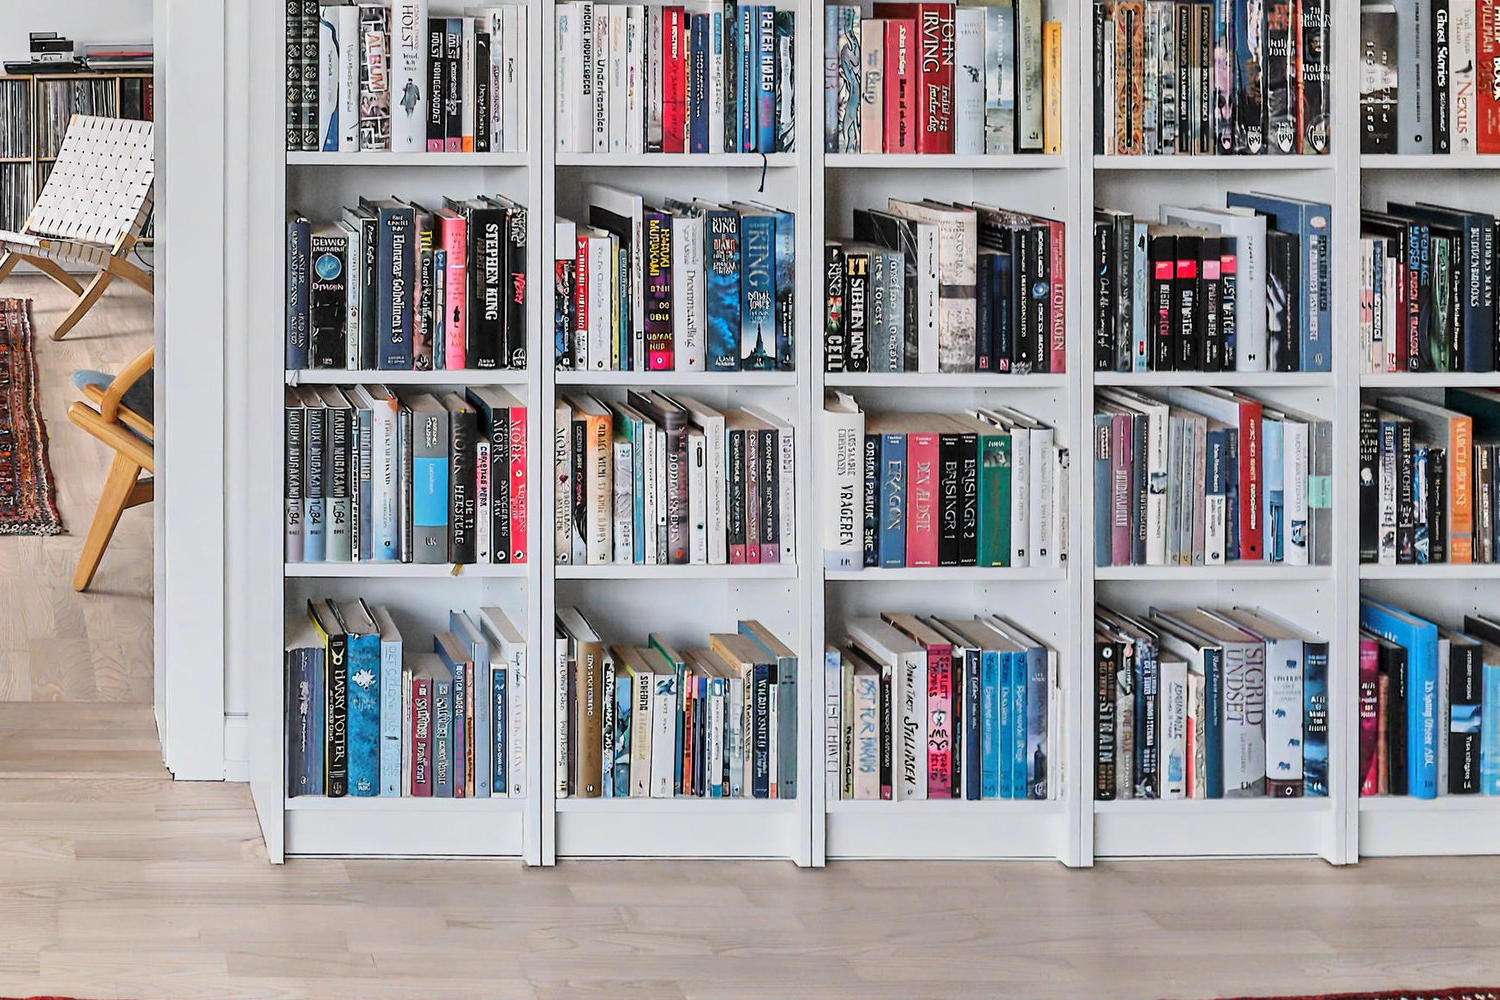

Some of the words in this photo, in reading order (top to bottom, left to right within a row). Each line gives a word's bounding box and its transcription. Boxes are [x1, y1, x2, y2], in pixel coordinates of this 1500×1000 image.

[402, 5, 413, 49] HOLST
[762, 12, 772, 51] PETER
[923, 11, 939, 72] IRVING
[942, 18, 954, 65] JOHN
[1437, 9, 1447, 43] Ghost
[366, 34, 384, 90] ALBUM
[1437, 47, 1447, 86] Stories
[1456, 81, 1471, 133] Nexus
[486, 223, 498, 285] STEPHEN
[748, 227, 766, 286] KING
[875, 256, 884, 279] new
[486, 289, 498, 320] KING
[850, 278, 864, 327] STEPHEN
[875, 287, 884, 324] forest
[828, 336, 841, 370] CELL
[851, 331, 865, 358] KING
[865, 442, 874, 479] ORHAN
[865, 482, 874, 519] PAMUK
[944, 461, 957, 531] BRISINGR
[962, 459, 976, 528] BRISINGR
[963, 531, 974, 539] 2
[334, 670, 345, 710] HARRY
[1226, 648, 1242, 726] UNDSET
[1245, 648, 1262, 726] SIGRID
[334, 715, 345, 761] POTTER
[1098, 704, 1113, 761] STRAIN
